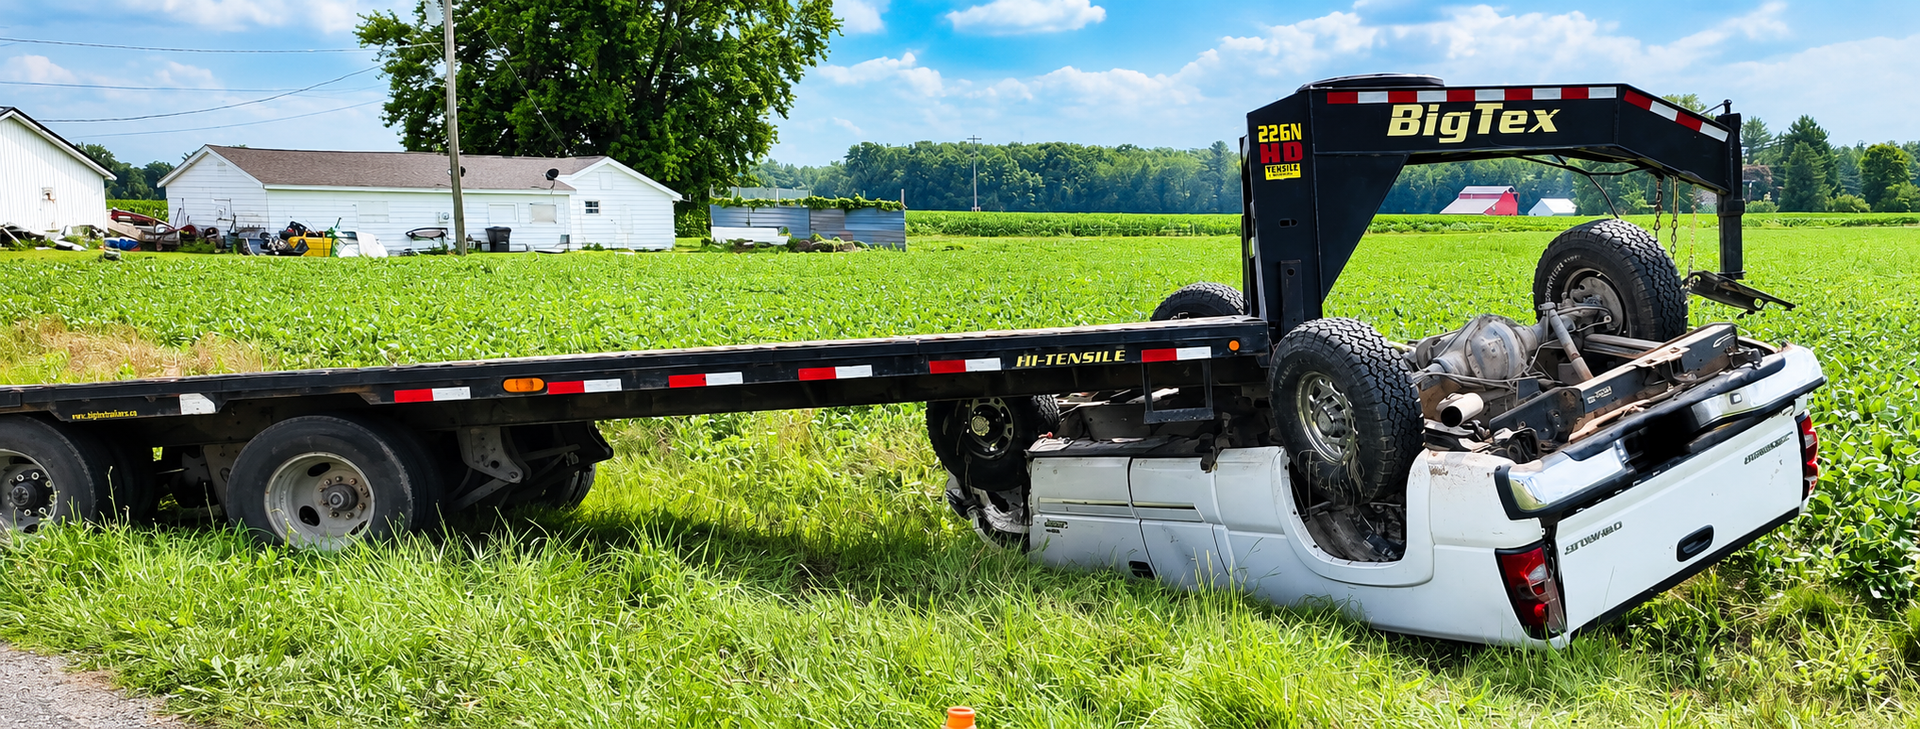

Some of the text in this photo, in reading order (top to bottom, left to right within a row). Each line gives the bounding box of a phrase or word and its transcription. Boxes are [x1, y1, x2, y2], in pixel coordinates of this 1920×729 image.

[1257, 122, 1302, 143] 226N
[1387, 103, 1561, 143] BigTex
[1260, 141, 1303, 164] HD
[1016, 349, 1126, 367] HI-TENSILE
